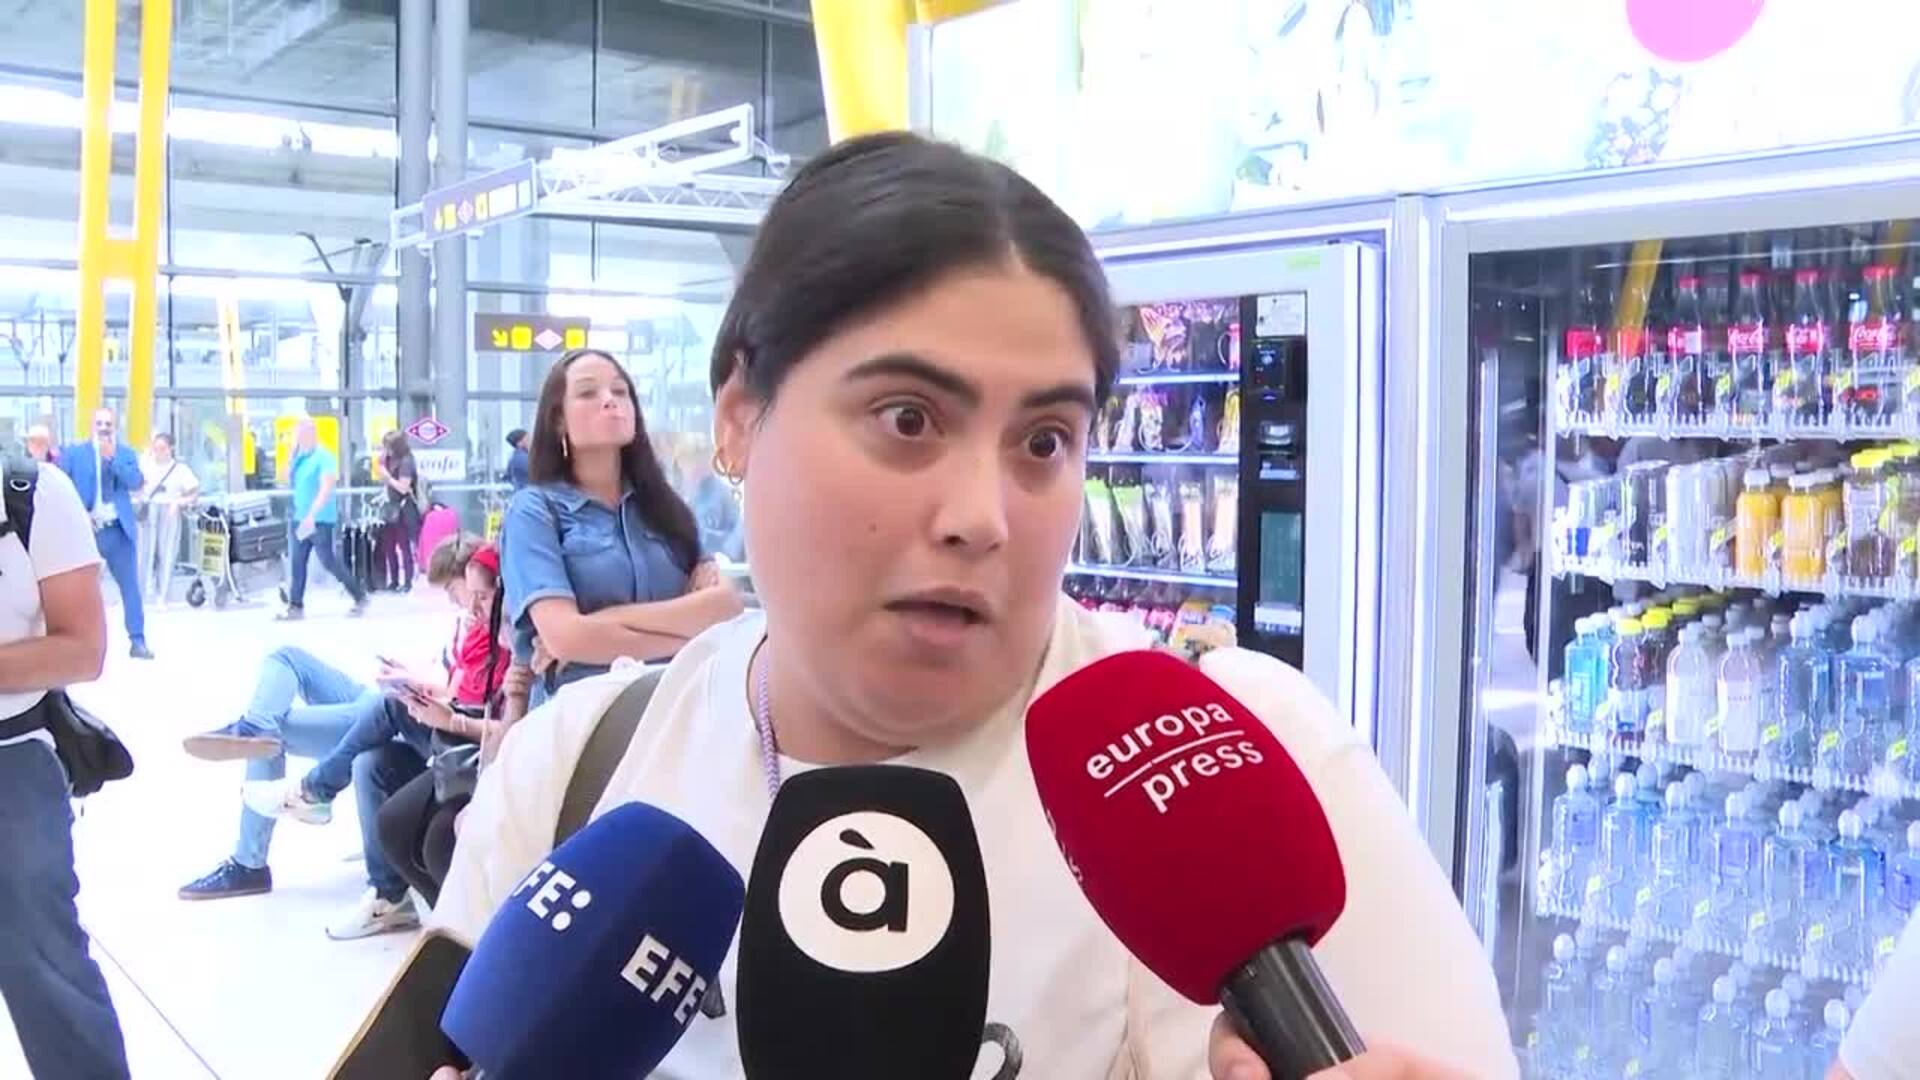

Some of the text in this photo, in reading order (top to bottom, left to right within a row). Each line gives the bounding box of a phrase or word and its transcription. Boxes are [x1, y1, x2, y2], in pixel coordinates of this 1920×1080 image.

[1086, 702, 1233, 780] europa
[1142, 741, 1264, 814] press
[512, 860, 592, 931] FE:
[820, 828, 909, 933] à
